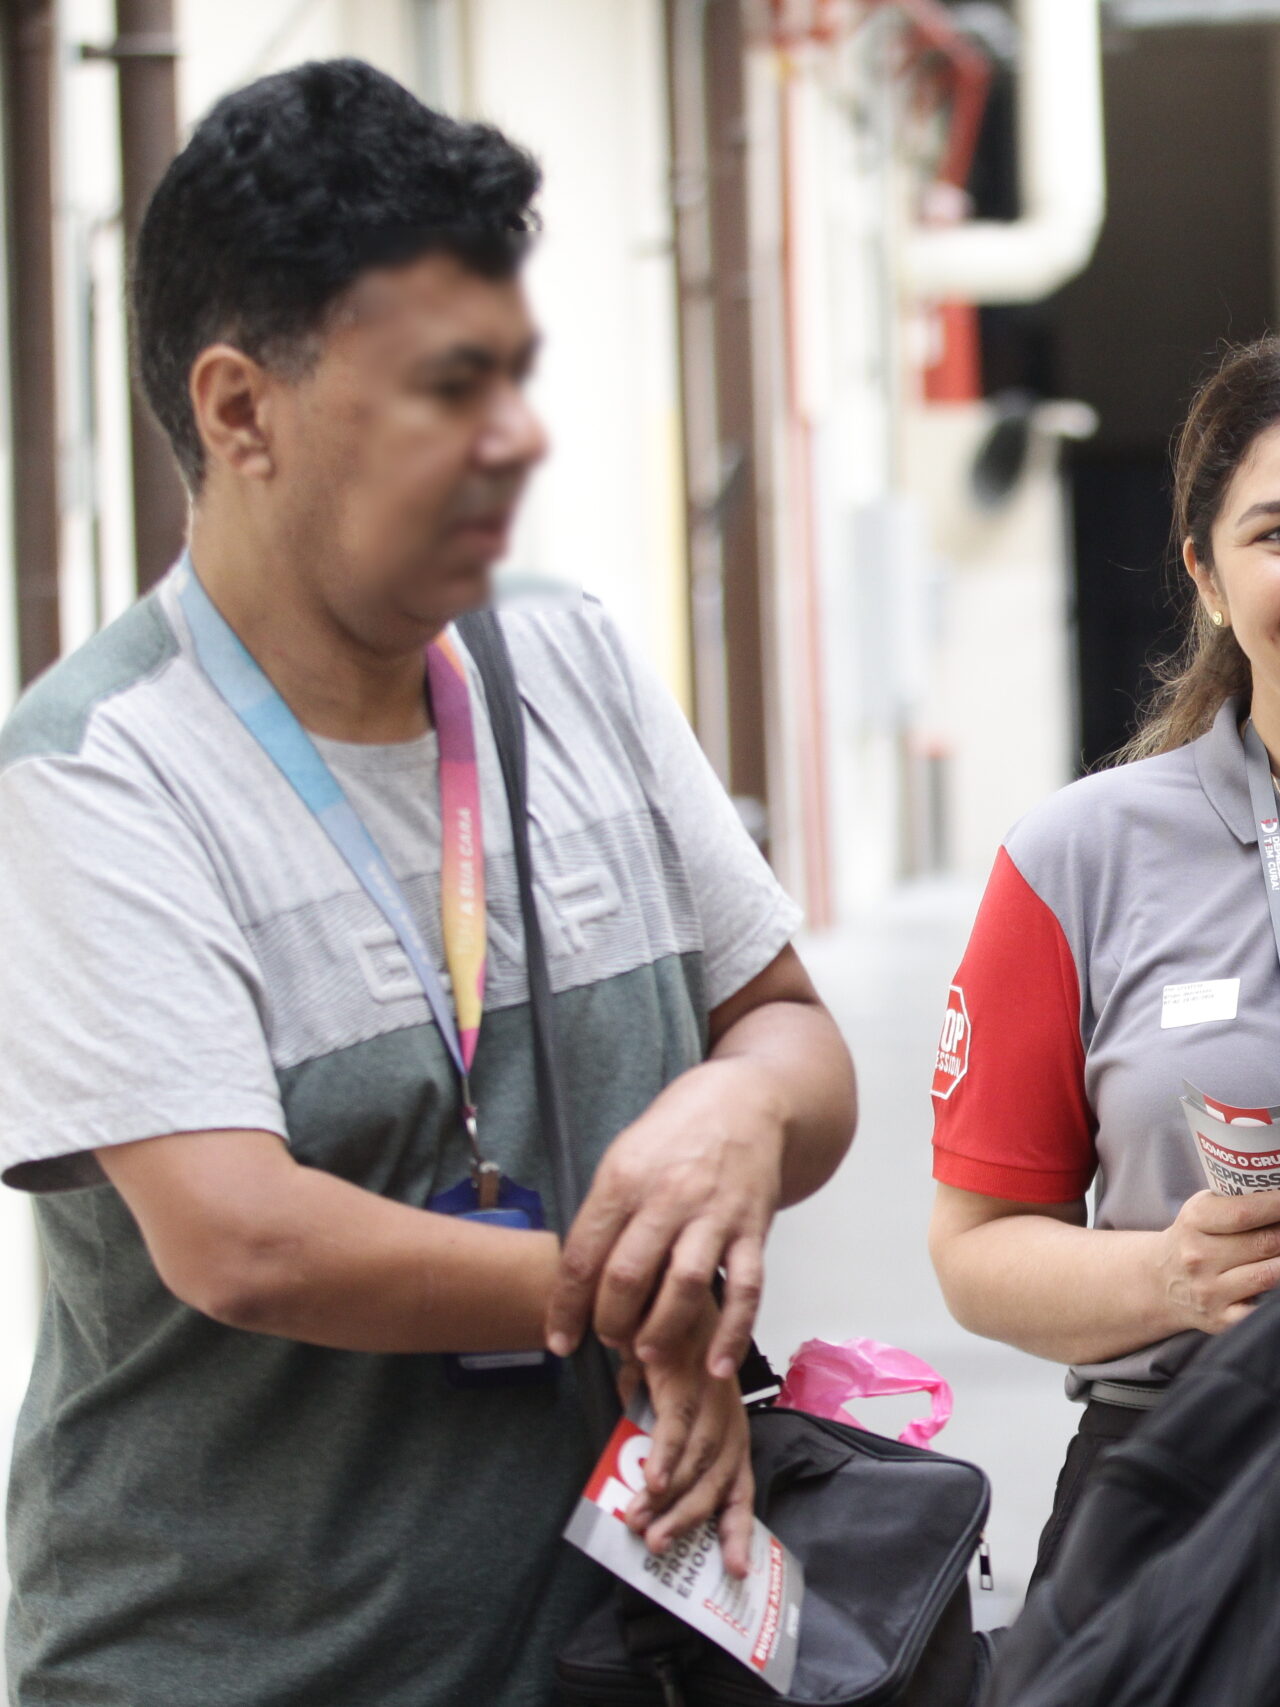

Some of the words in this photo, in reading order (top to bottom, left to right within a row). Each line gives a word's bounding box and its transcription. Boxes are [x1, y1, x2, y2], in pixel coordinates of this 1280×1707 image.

[458, 808, 472, 857] CARA
[1264, 837, 1274, 859] TEM
[458, 861, 474, 898] SUA
[1268, 861, 1280, 891] CURA!
[940, 1008, 965, 1053] OP
[935, 1051, 961, 1077] ESSION
[1200, 1138, 1236, 1165] SOMOS
[1237, 1156, 1249, 1167] O
